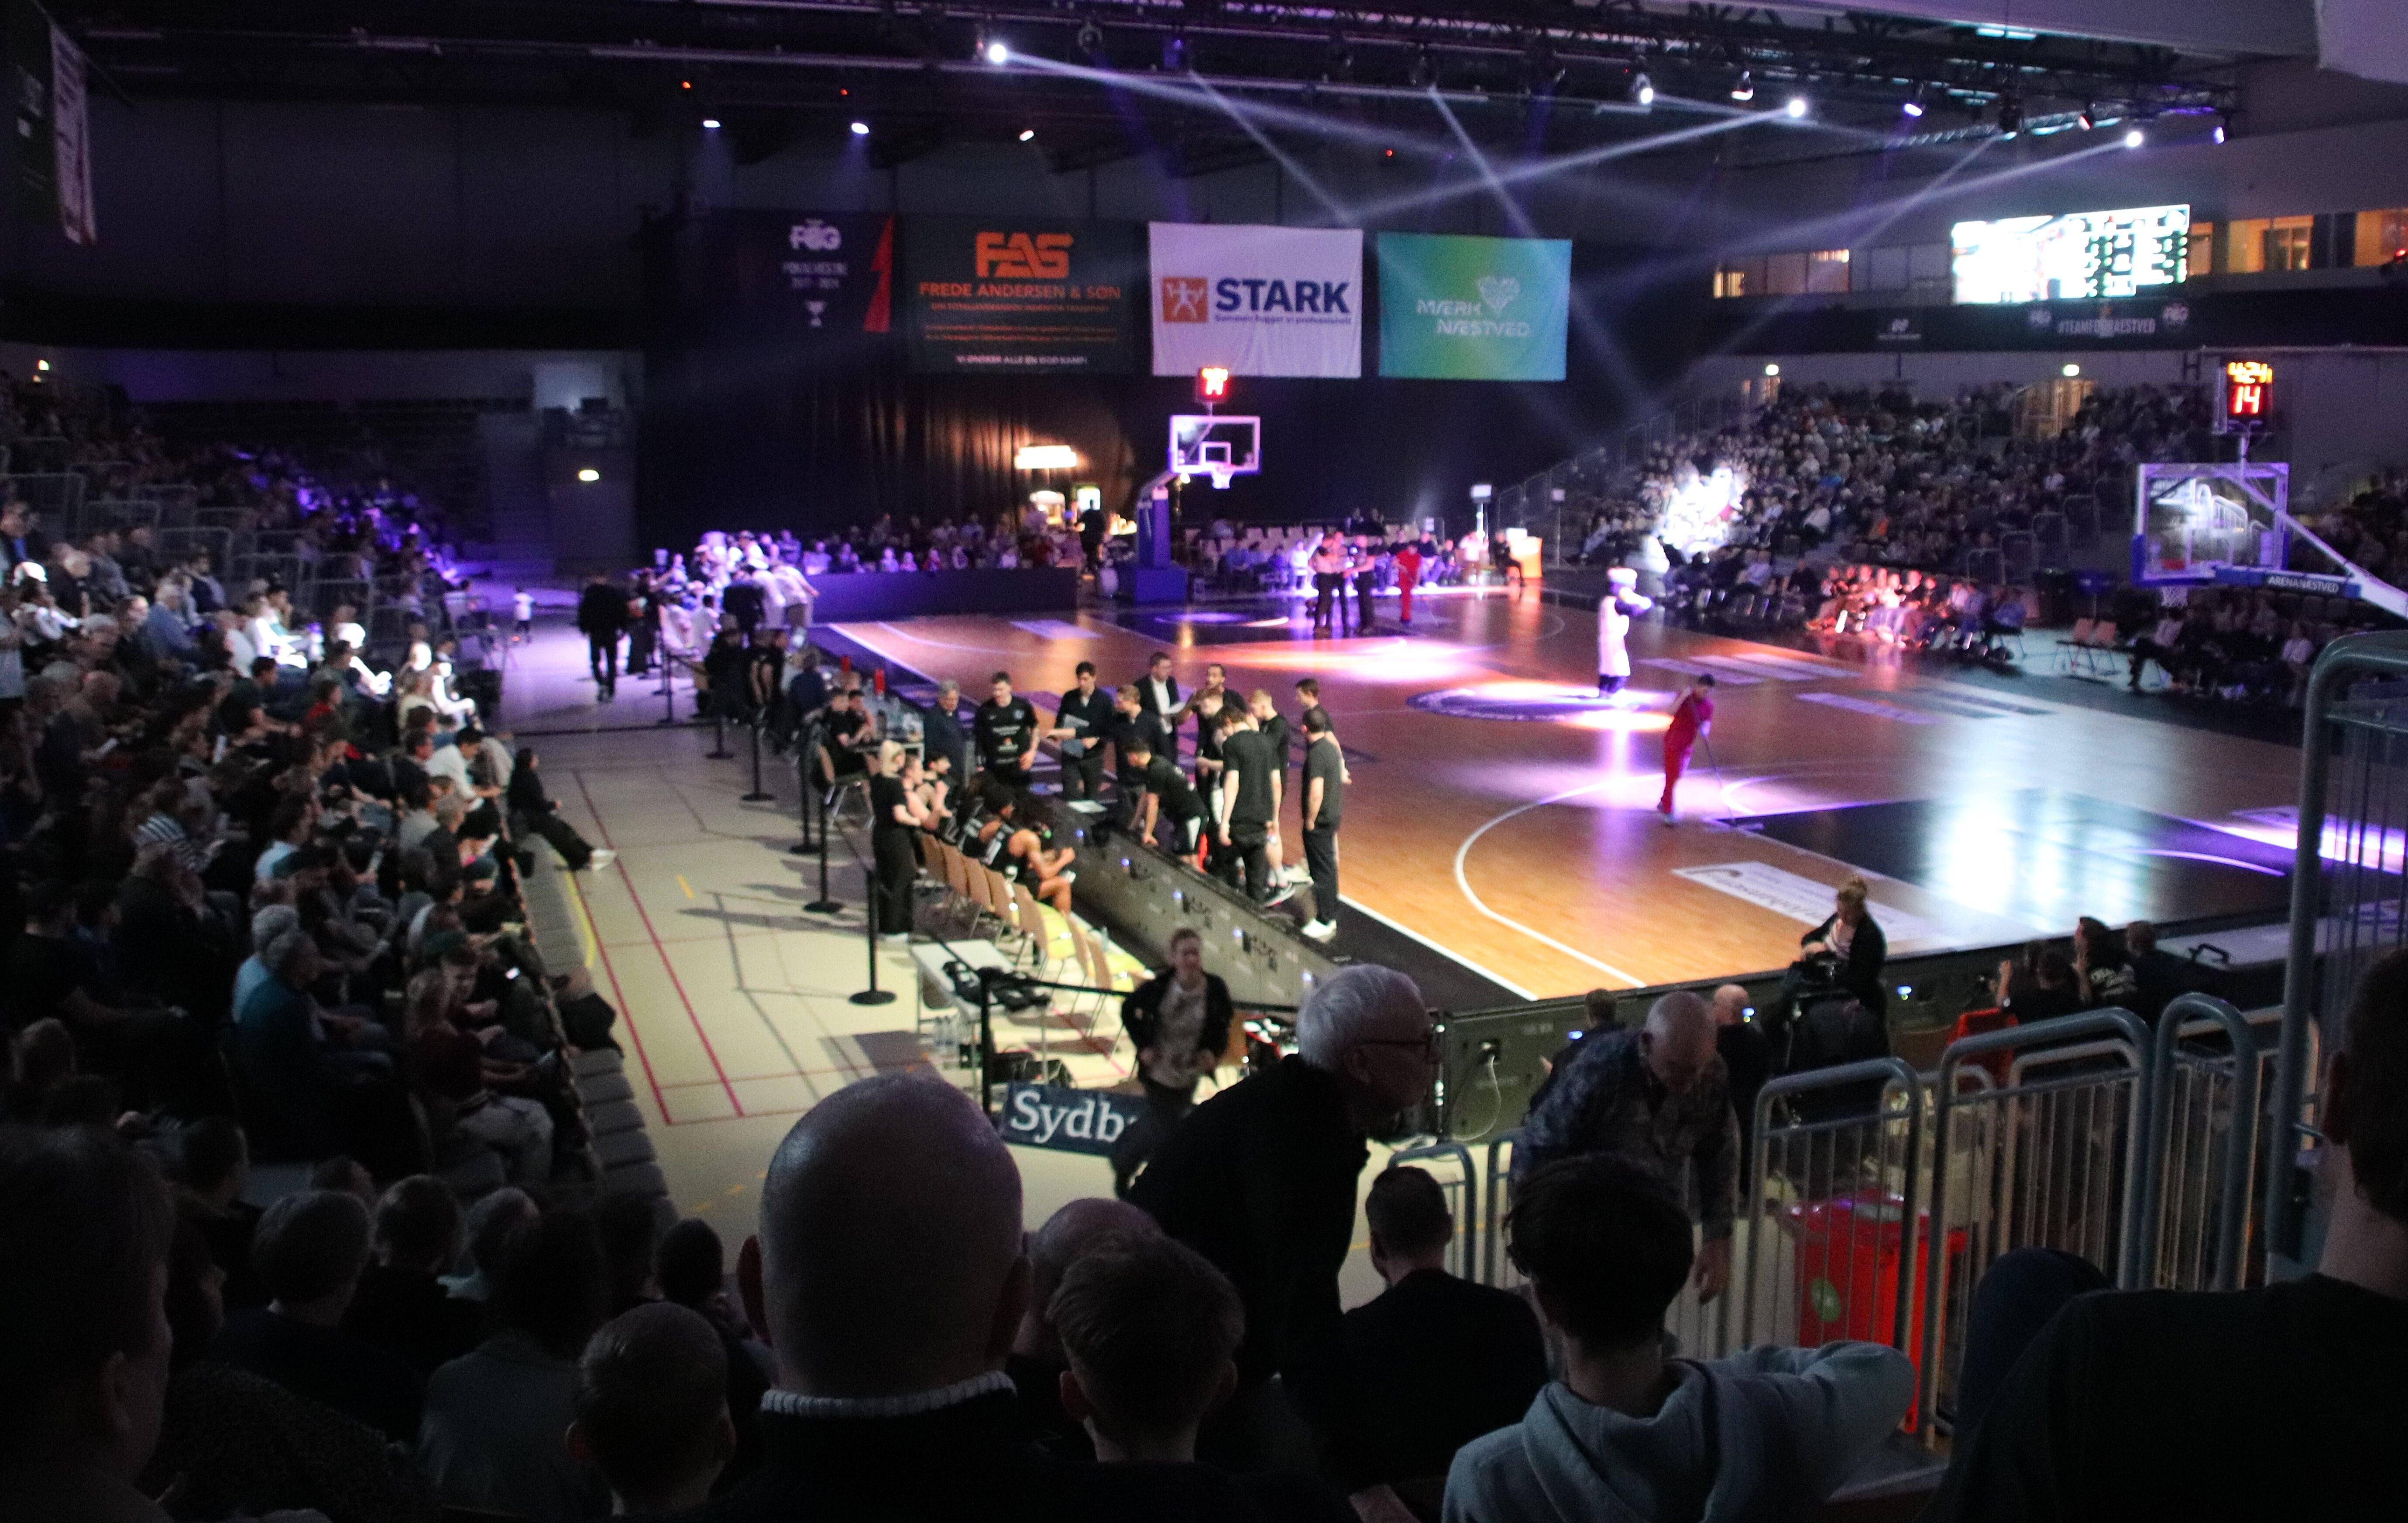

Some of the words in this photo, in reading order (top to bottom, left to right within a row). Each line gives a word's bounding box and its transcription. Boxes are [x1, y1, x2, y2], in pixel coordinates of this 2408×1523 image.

[976, 232, 1075, 279] FAS
[919, 282, 972, 297] FREDE
[976, 284, 1066, 298] ANDERSEN
[1085, 286, 1121, 299] SØN
[1216, 278, 1351, 314] STARK
[1436, 319, 1529, 337] NÆSTVED
[2234, 385, 2261, 414] 14
[2268, 576, 2299, 587] ARENA
[2301, 578, 2339, 593] NÆSTVED
[1010, 1090, 1138, 1144] Sydb
